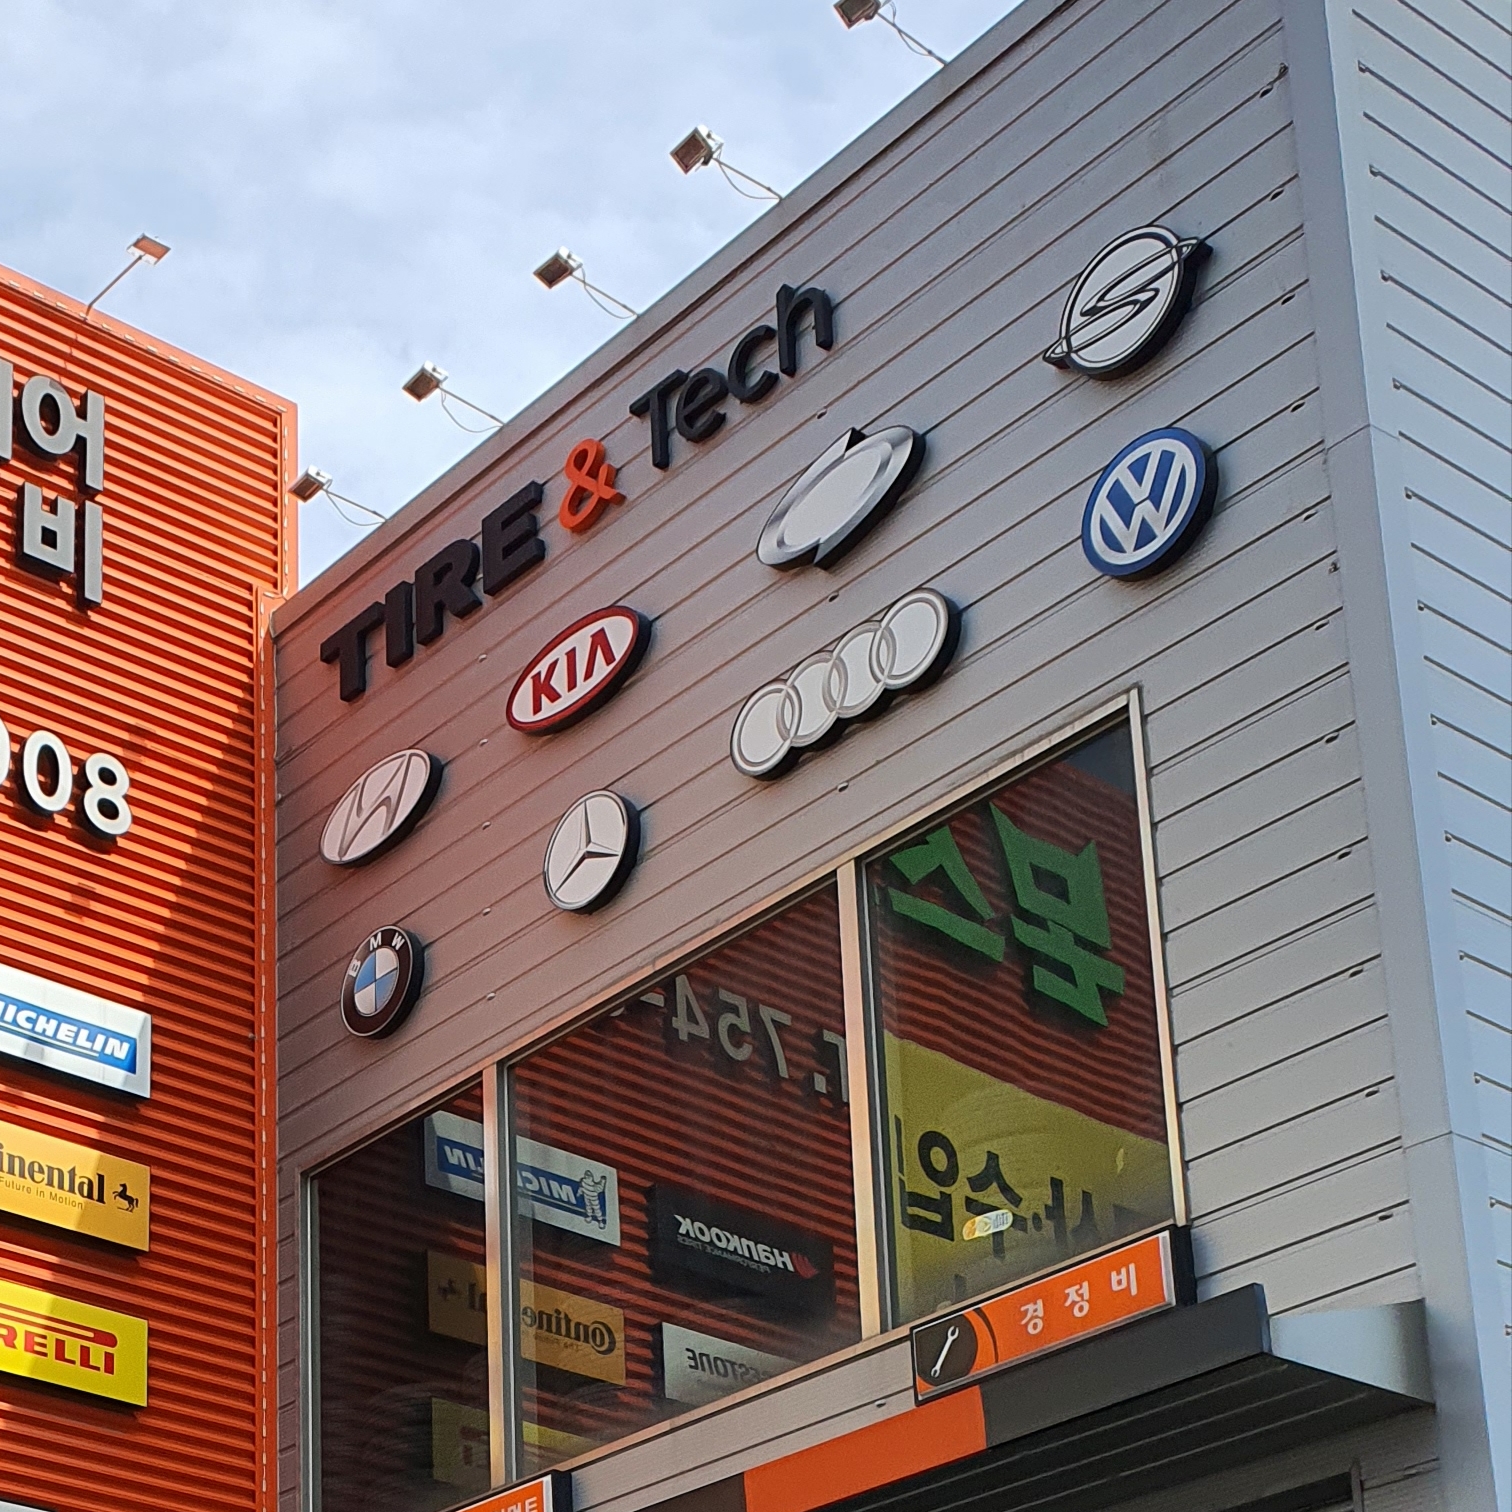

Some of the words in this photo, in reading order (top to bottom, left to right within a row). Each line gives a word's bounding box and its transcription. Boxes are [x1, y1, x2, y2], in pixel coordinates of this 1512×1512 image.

[320, 480, 546, 703] TIRE
[558, 438, 626, 533] &
[629, 284, 836, 471] Tech
[530, 627, 618, 716] KIA
[348, 932, 405, 978] BMW
[36, 1186, 45, 1199] in
[49, 1190, 85, 1210] Motion
